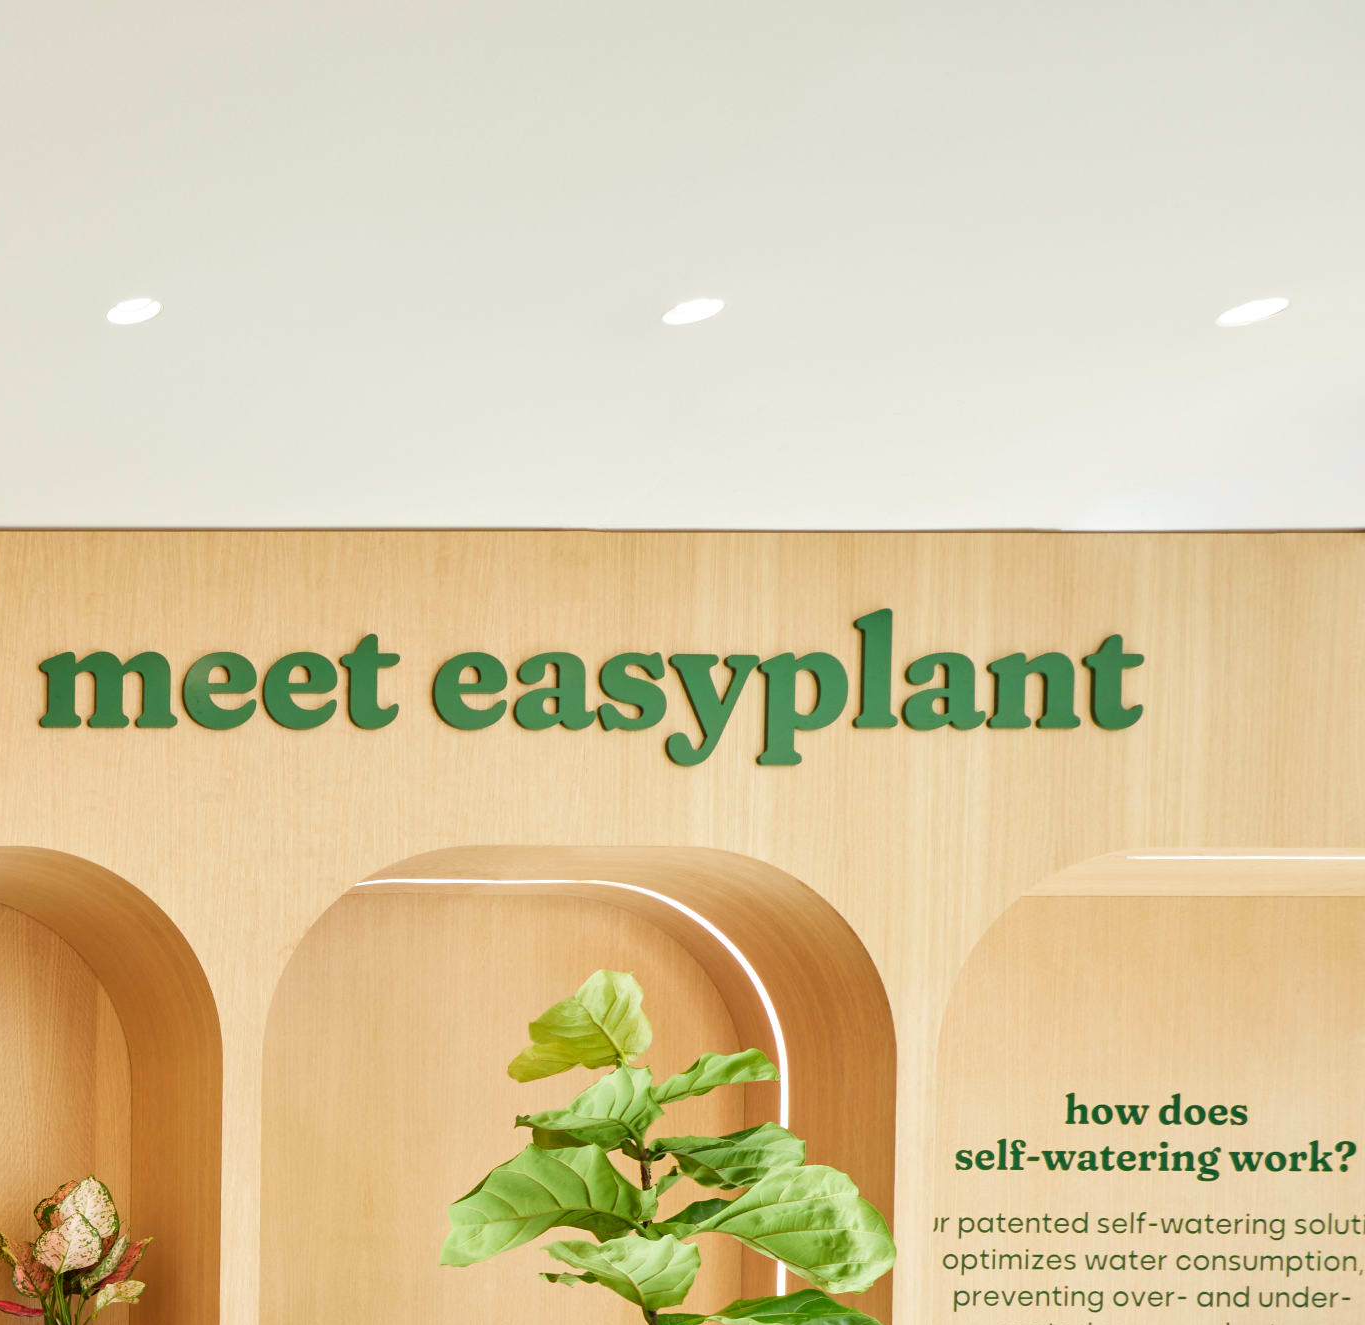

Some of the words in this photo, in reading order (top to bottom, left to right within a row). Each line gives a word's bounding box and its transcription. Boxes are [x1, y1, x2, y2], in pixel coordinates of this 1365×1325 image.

[38, 632, 401, 731] meet
[432, 606, 1145, 767] easyplant
[1065, 1092, 1151, 1126] how
[1158, 1092, 1249, 1126] does
[954, 1138, 1222, 1182] self-watering
[1228, 1139, 1357, 1174] work?
[957, 1211, 1089, 1239] patented
[1097, 1211, 1286, 1241] self-watering
[941, 1248, 1077, 1276] optimizes
[1084, 1250, 1168, 1272] water
[1174, 1249, 1364, 1278] consumption,
[953, 1285, 1104, 1313] preventing
[1112, 1289, 1188, 1308] over-
[1195, 1285, 1250, 1308] and
[1258, 1285, 1351, 1309] under-
